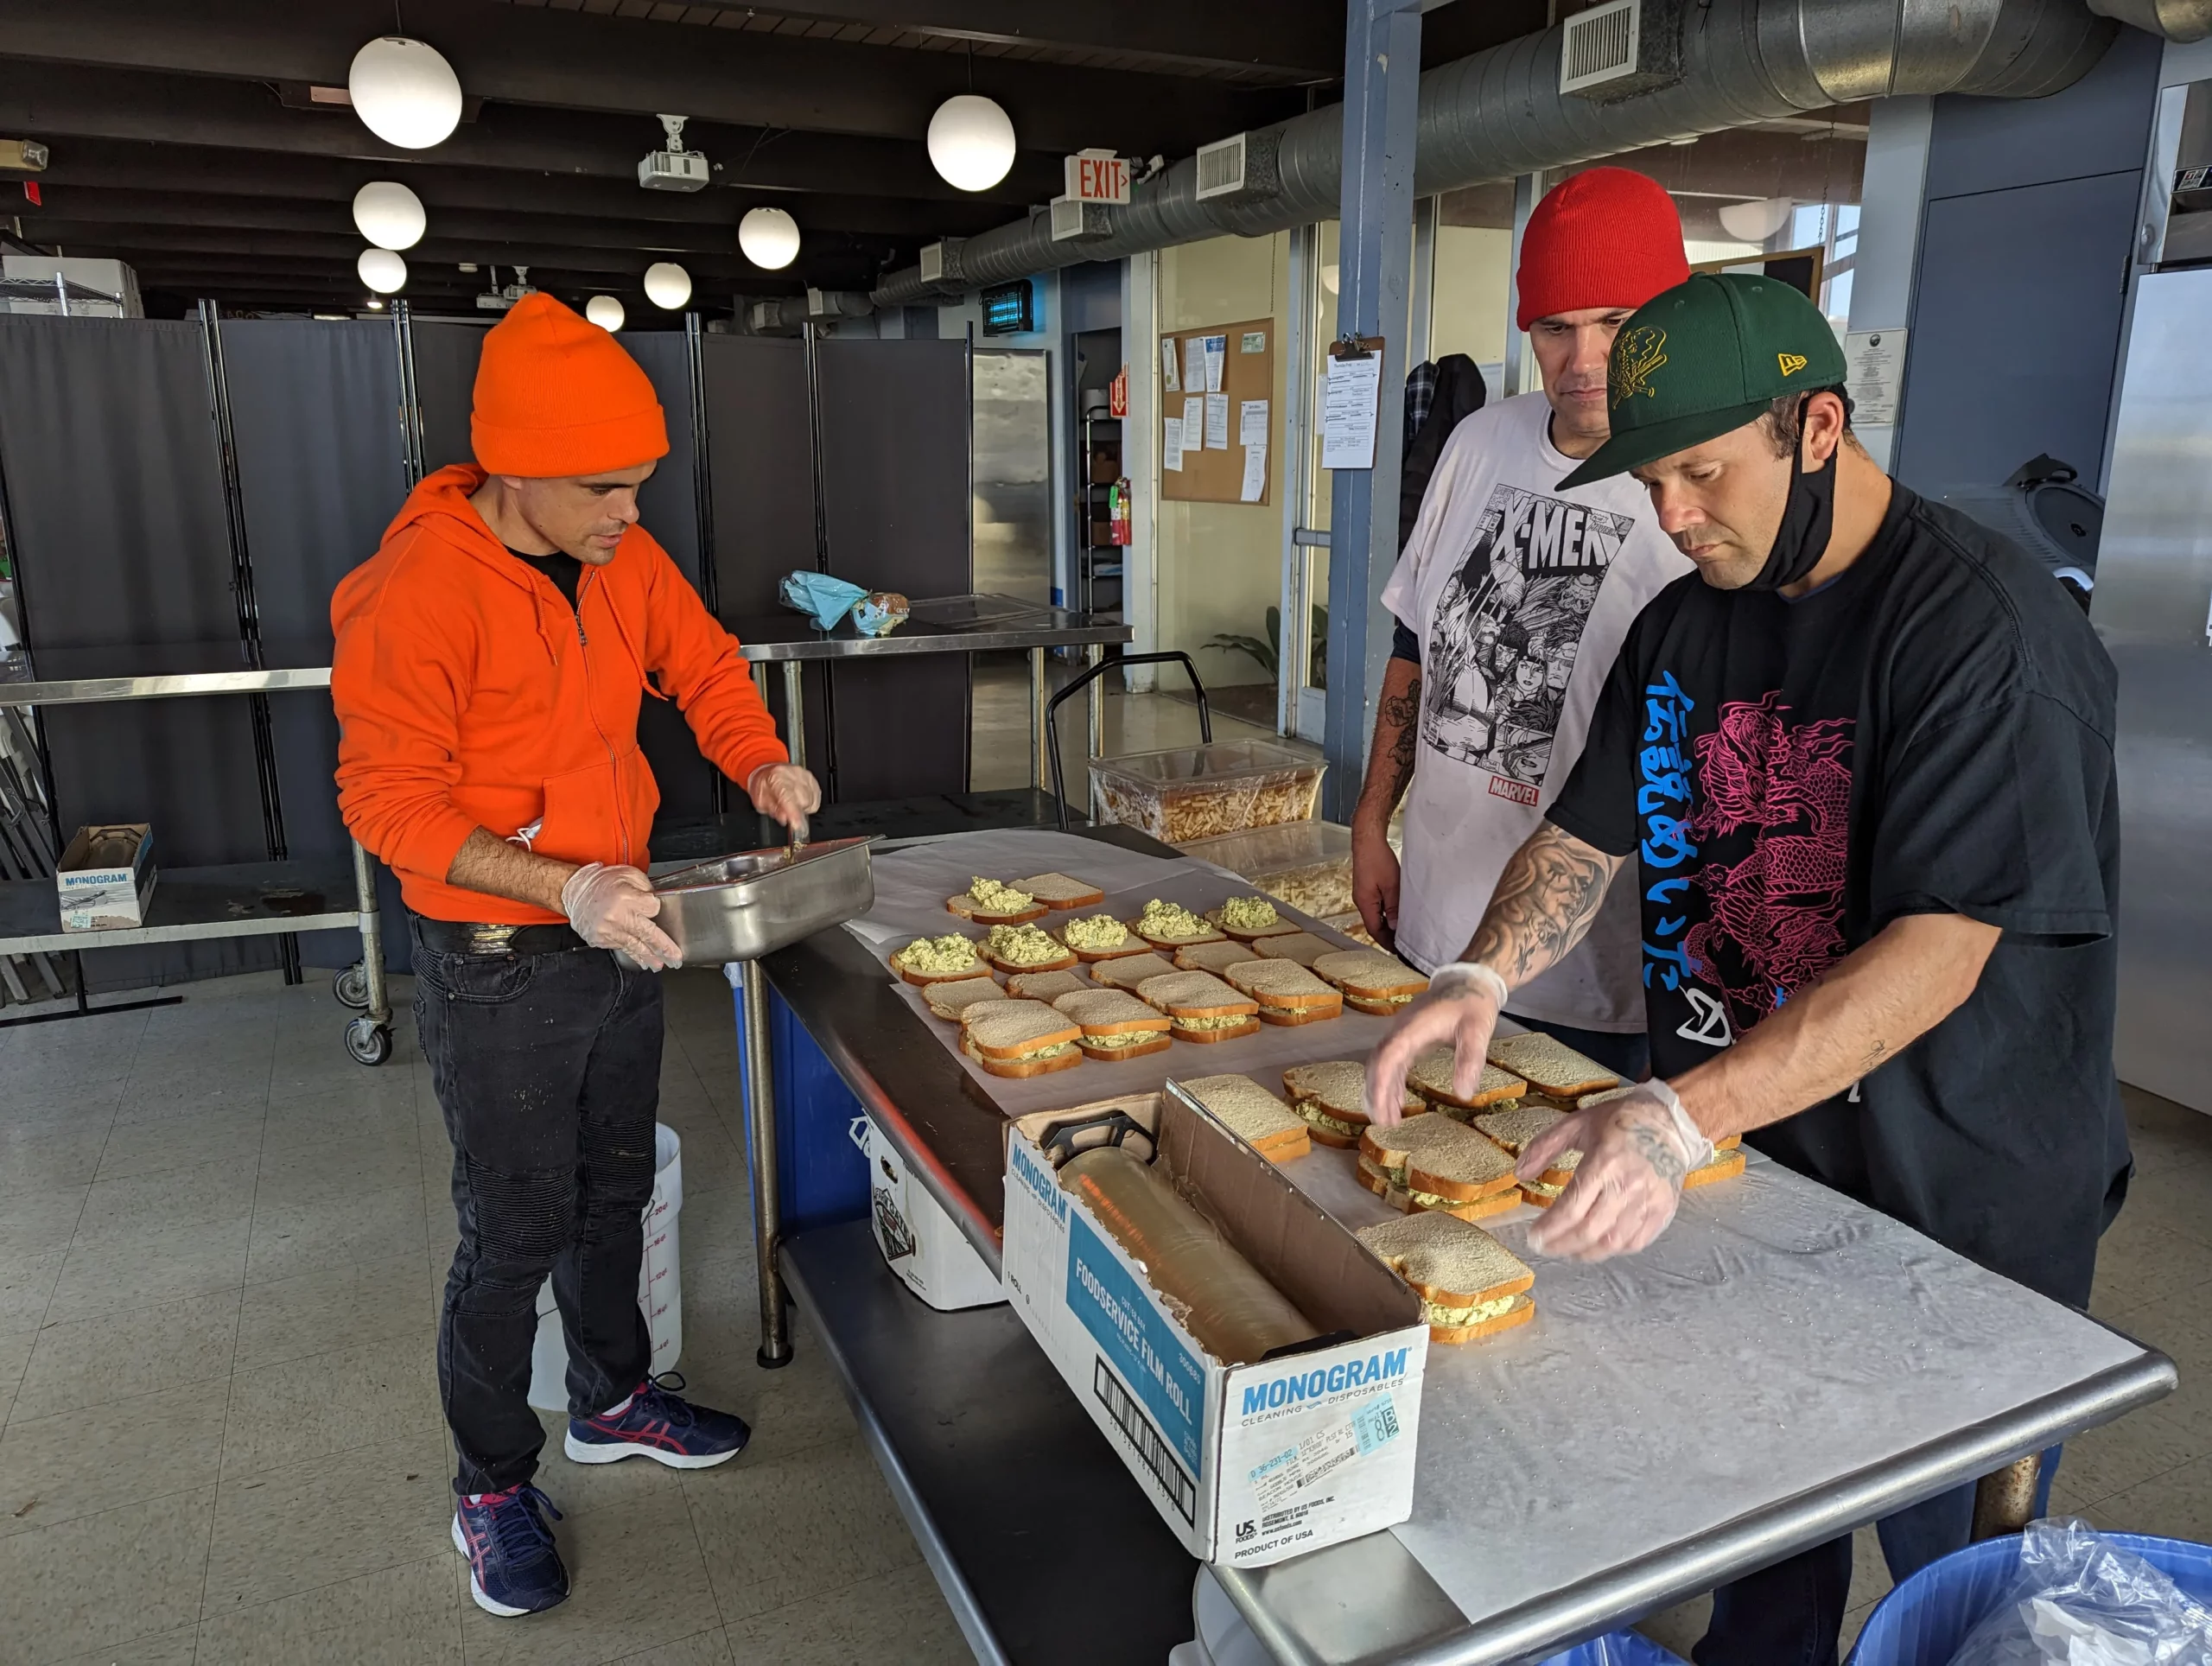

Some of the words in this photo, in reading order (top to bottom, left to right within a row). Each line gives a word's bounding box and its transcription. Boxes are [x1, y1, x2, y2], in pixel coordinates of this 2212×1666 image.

[1080, 159, 1122, 199] EXIT
[1490, 493, 1612, 570] X-MEN
[1491, 777, 1535, 804] MARVEL
[66, 874, 127, 886] MONOGRAM
[1012, 1143, 1067, 1223] MONOGRAM
[654, 1203, 669, 1216] 20qt
[1011, 1168, 1031, 1193] CLEANING
[1037, 1199, 1065, 1233] DISPOSABLES
[654, 1233, 666, 1246] 16qt
[655, 1268, 668, 1280] 12qt
[1011, 1276, 1022, 1294] ROLL
[657, 1303, 668, 1315] 8qt
[658, 1339, 670, 1351] 4qt
[1076, 1256, 1140, 1350] FOODSERVICE
[1141, 1338, 1164, 1386] FILM
[1166, 1371, 1192, 1426] ROLL
[1242, 1347, 1408, 1416] MONOGRAM
[1242, 1405, 1303, 1427] CLEANING
[1327, 1377, 1404, 1404] DISPOSABLES
[1384, 1409, 1395, 1424] B
[1388, 1423, 1397, 1437] 2
[1345, 1430, 1353, 1440] 15
[1259, 1449, 1293, 1473] 36-231-02
[1299, 1437, 1314, 1449] 1/01
[1316, 1430, 1325, 1439] CS
[1259, 1485, 1281, 1501] BEACON
[1284, 1473, 1302, 1486] HOUSE
[1235, 1539, 1279, 1559] PRODUCT
[1281, 1535, 1294, 1545] OF
[1295, 1529, 1313, 1542] USA
